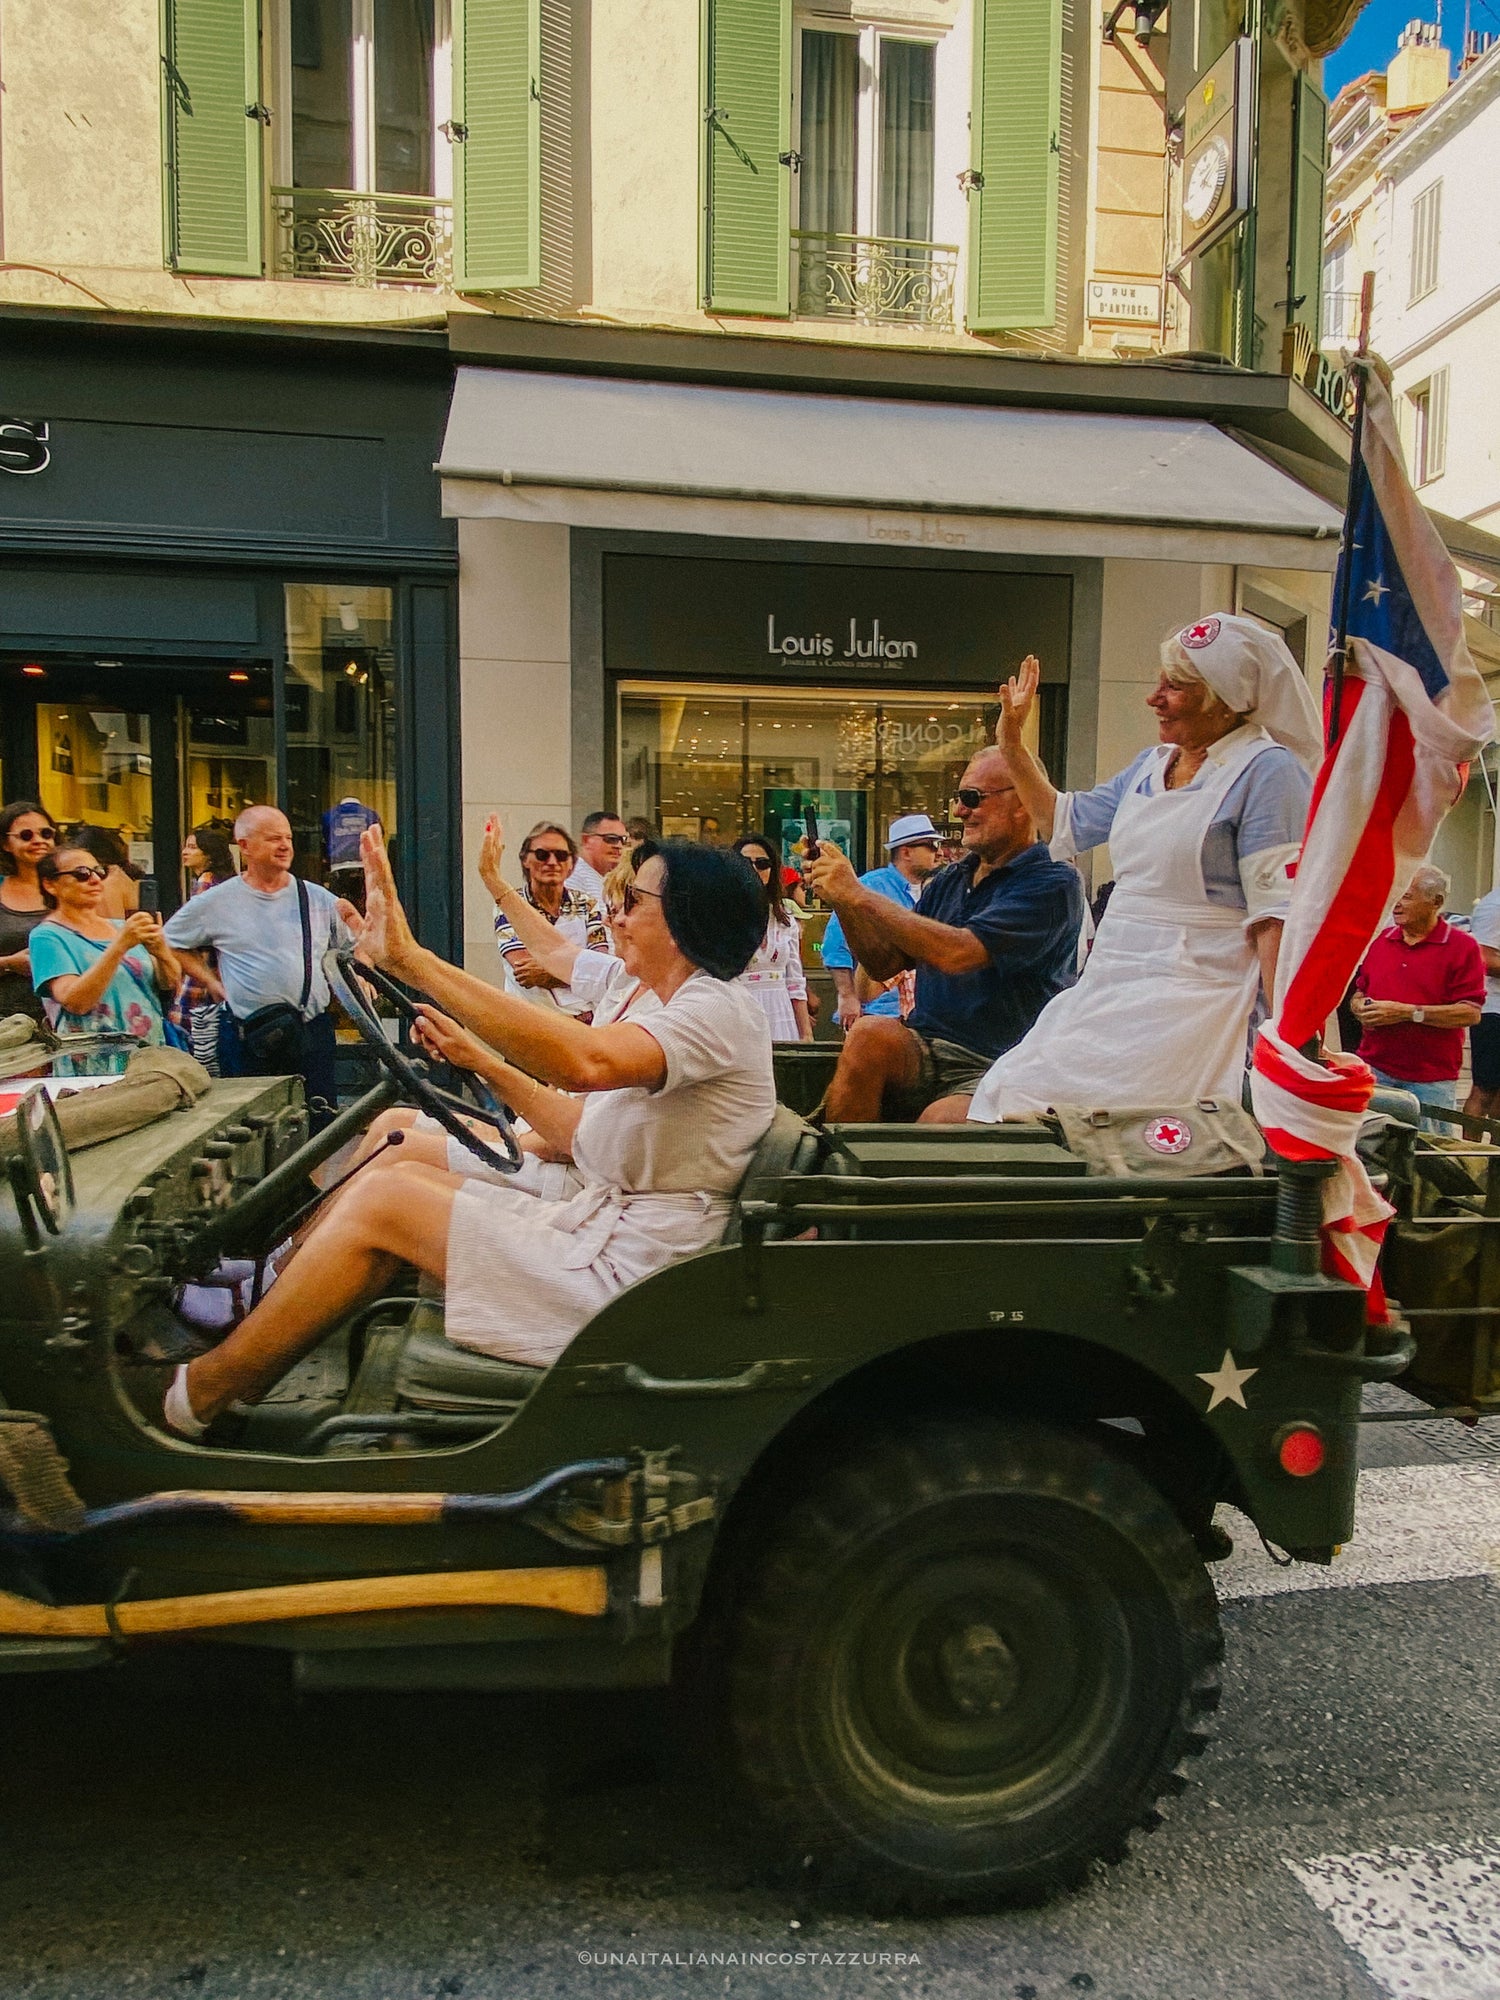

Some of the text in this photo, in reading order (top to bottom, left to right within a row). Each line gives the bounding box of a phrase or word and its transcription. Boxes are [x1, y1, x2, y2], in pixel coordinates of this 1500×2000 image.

[1111, 287, 1137, 299] RUE
[767, 613, 919, 659] Louis Julian
